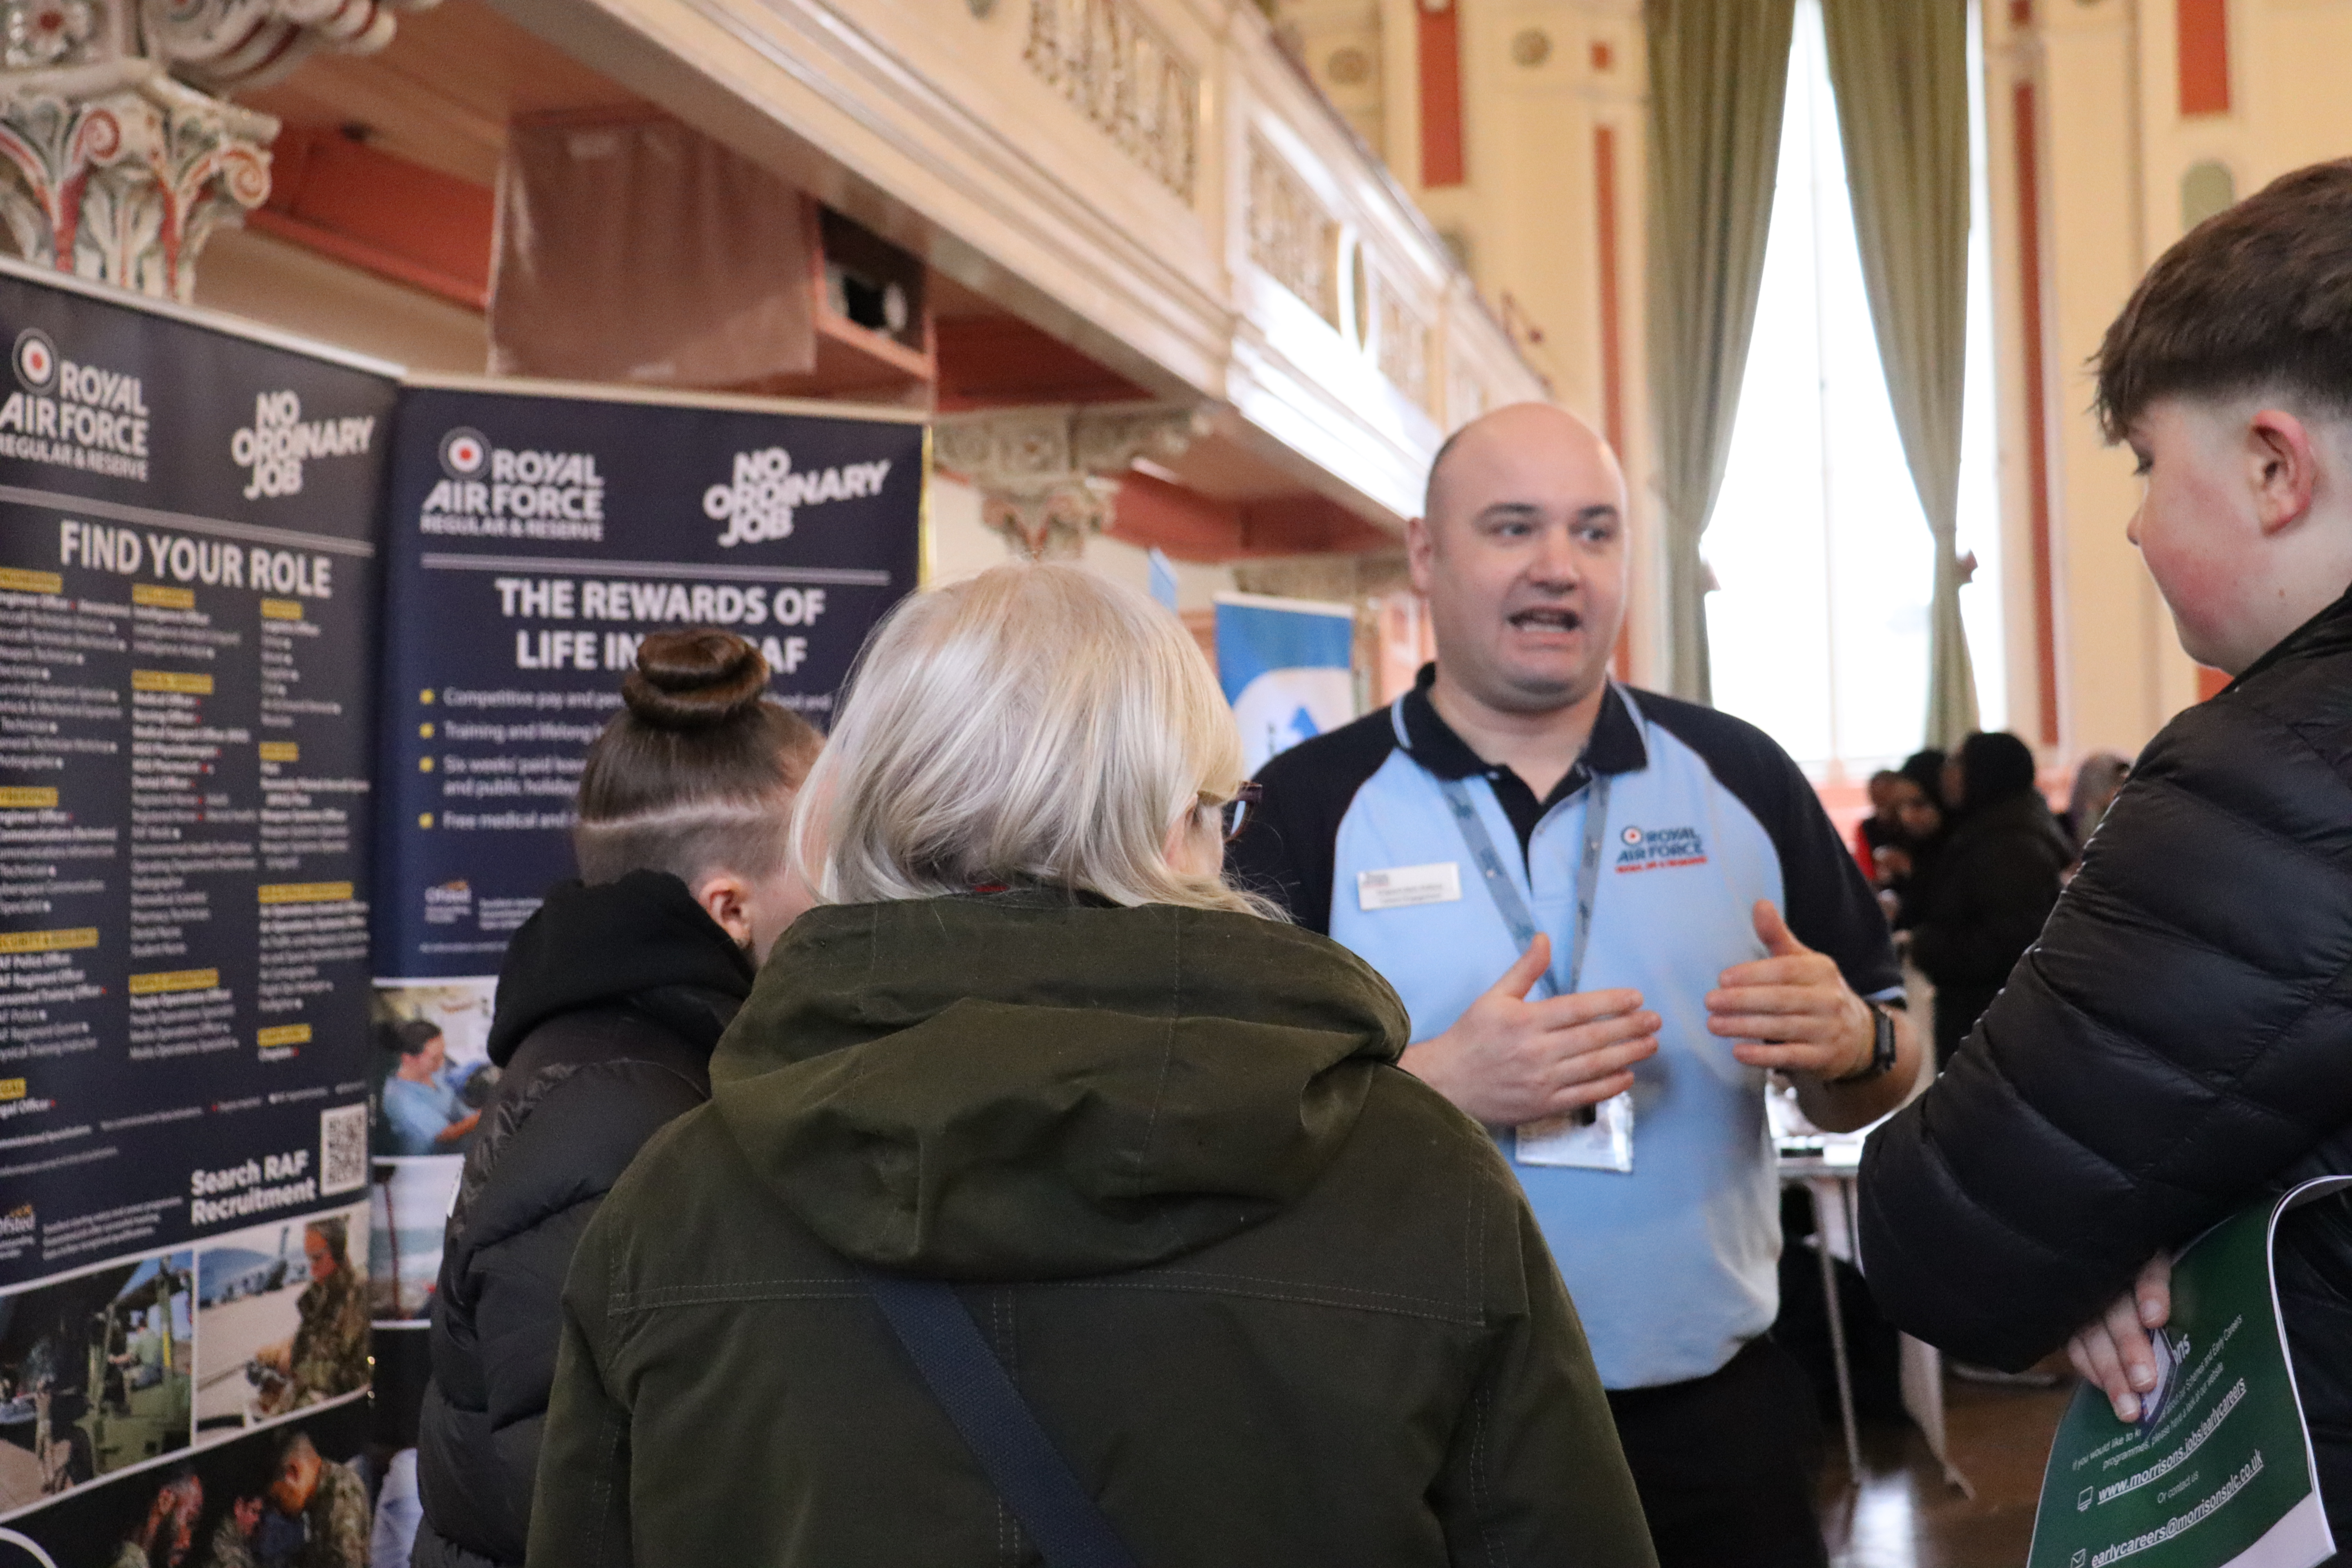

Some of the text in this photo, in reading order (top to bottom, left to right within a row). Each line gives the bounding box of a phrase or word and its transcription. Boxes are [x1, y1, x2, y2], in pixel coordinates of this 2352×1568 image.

[60, 360, 149, 416] ROYAL
[255, 389, 300, 428] NO
[0, 392, 149, 456] AIR FORCE
[232, 416, 375, 467] ORDINARY
[244, 461, 304, 500] JOB
[492, 448, 605, 487] ROYAL
[733, 446, 791, 479] NO
[421, 479, 605, 521] AIR FORCE
[703, 459, 891, 519] ORDINARY
[717, 508, 794, 548] JOB
[60, 519, 142, 575] FIND
[148, 535, 243, 589] YOUR
[249, 548, 333, 599] ROLE
[494, 577, 826, 626] THE REWARDS OF
[516, 629, 597, 670] LIFE
[604, 631, 644, 671] IN
[1615, 840, 1704, 863] AIR FORCE
[1645, 827, 1701, 842] ROYAL
[191, 1148, 310, 1196] Search RAF
[191, 1176, 317, 1226] Recruitment
[2090, 1441, 2111, 1459] would
[2111, 1436, 2125, 1448] like
[2098, 1377, 2246, 1504] www.morrisons.jobs/earlycareers
[2157, 1470, 2199, 1504] Or contact us
[2091, 1449, 2264, 1568] earlycareers@morrisonsplc.co.uk
